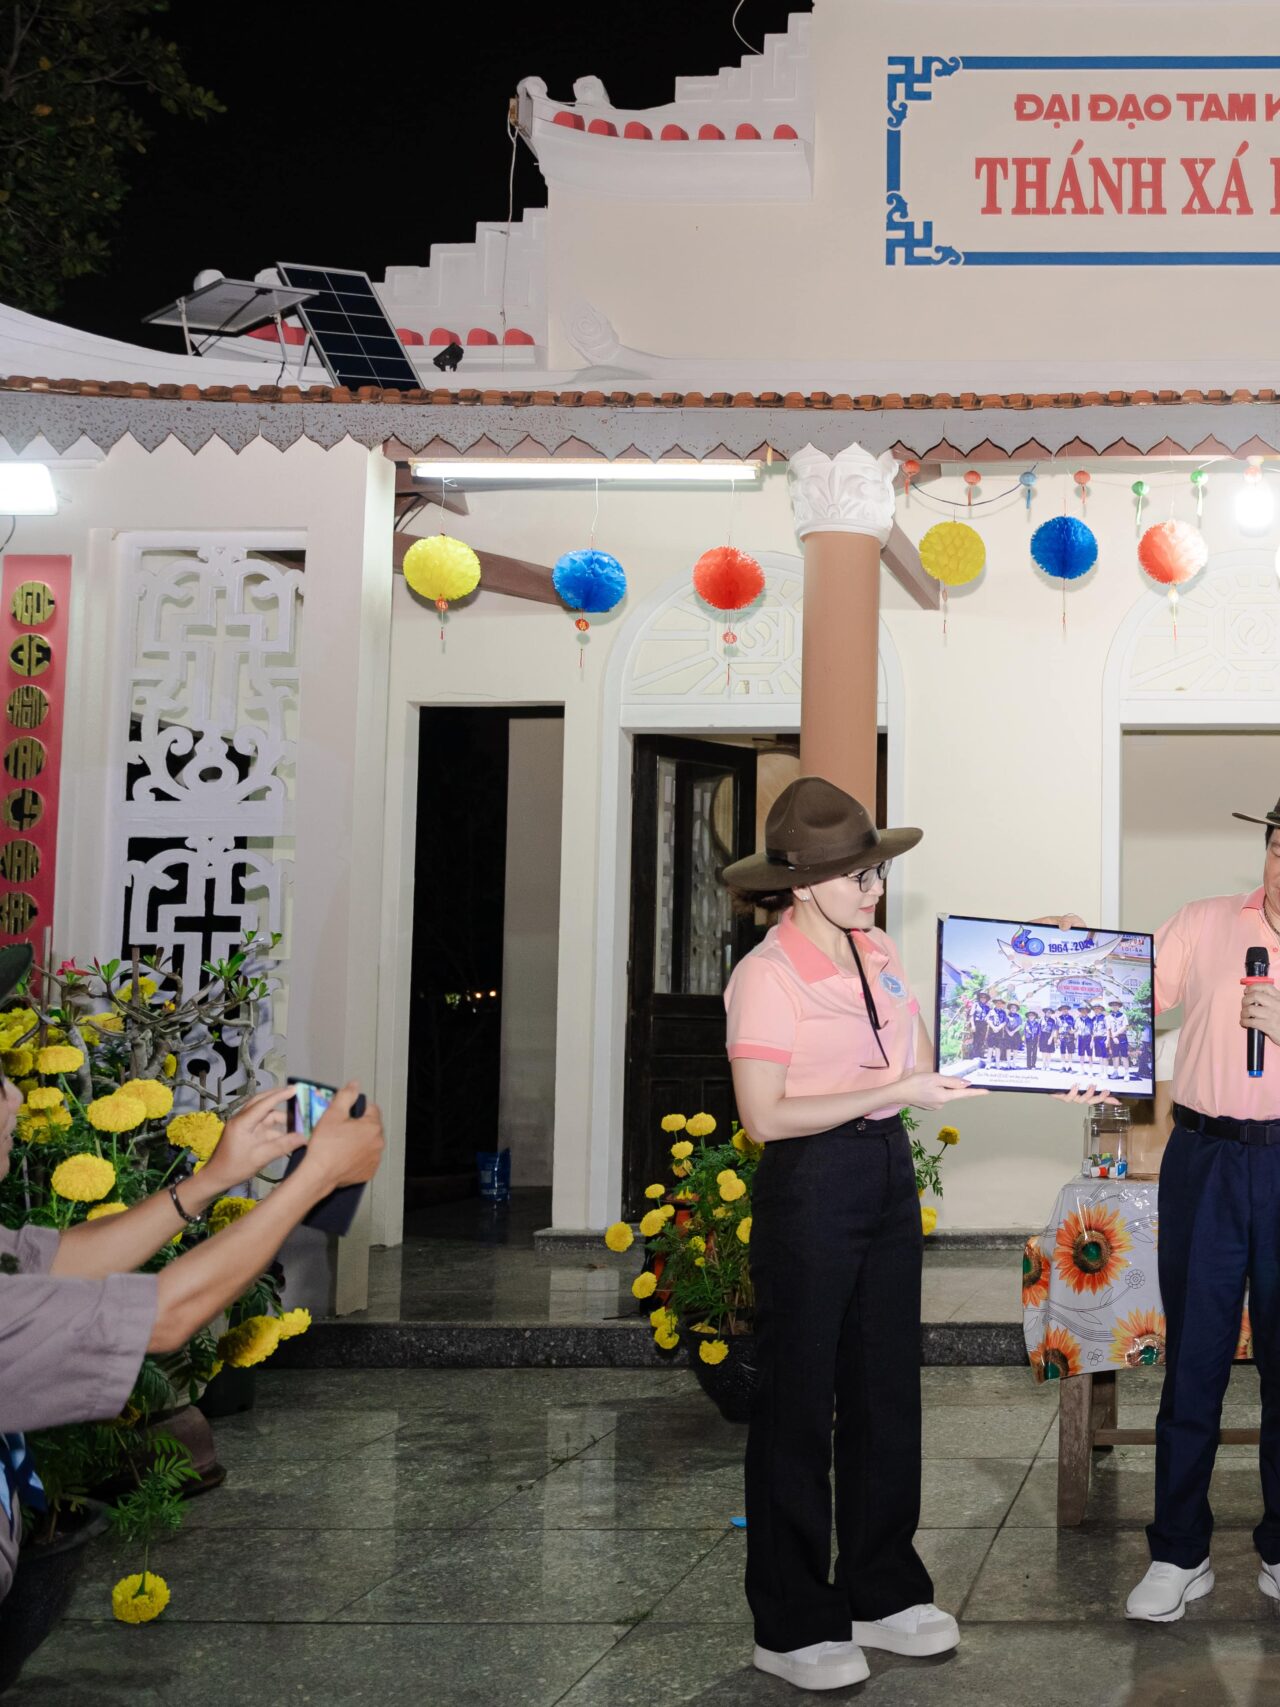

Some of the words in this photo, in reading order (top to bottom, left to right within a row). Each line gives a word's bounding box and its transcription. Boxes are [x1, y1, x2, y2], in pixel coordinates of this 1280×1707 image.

[1014, 93, 1081, 130] ĐẠI
[1088, 93, 1172, 130] ĐẠO
[1176, 92, 1257, 122] TAM
[974, 138, 1168, 216] THÁNH
[1179, 139, 1255, 216] XÁ
